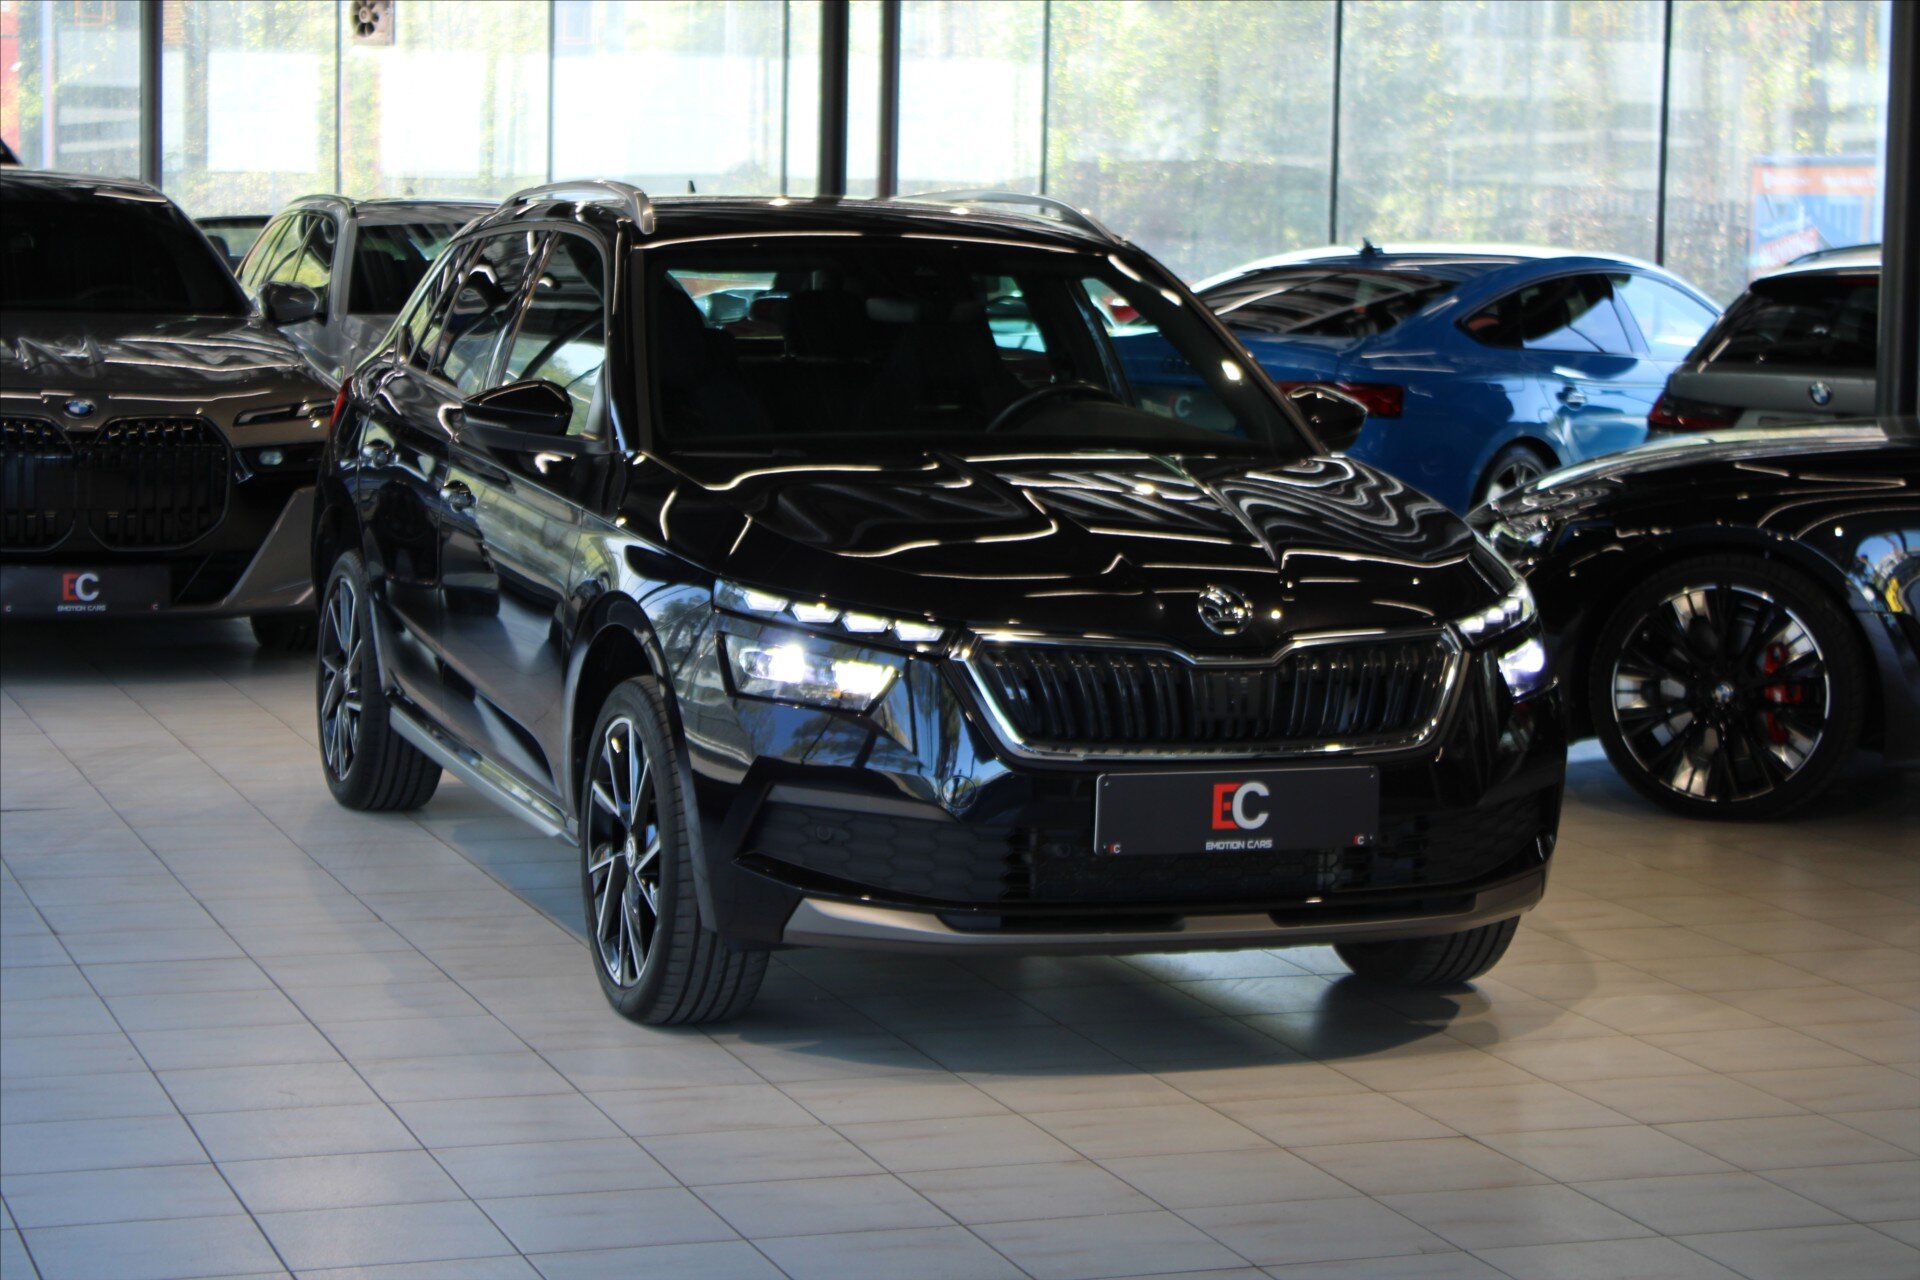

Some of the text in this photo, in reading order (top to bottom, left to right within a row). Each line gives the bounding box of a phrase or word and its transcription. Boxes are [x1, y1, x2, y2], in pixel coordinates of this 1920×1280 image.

[62, 572, 99, 601] EC
[1212, 782, 1269, 830] EC
[1205, 839, 1273, 851] EMOTION CARS
